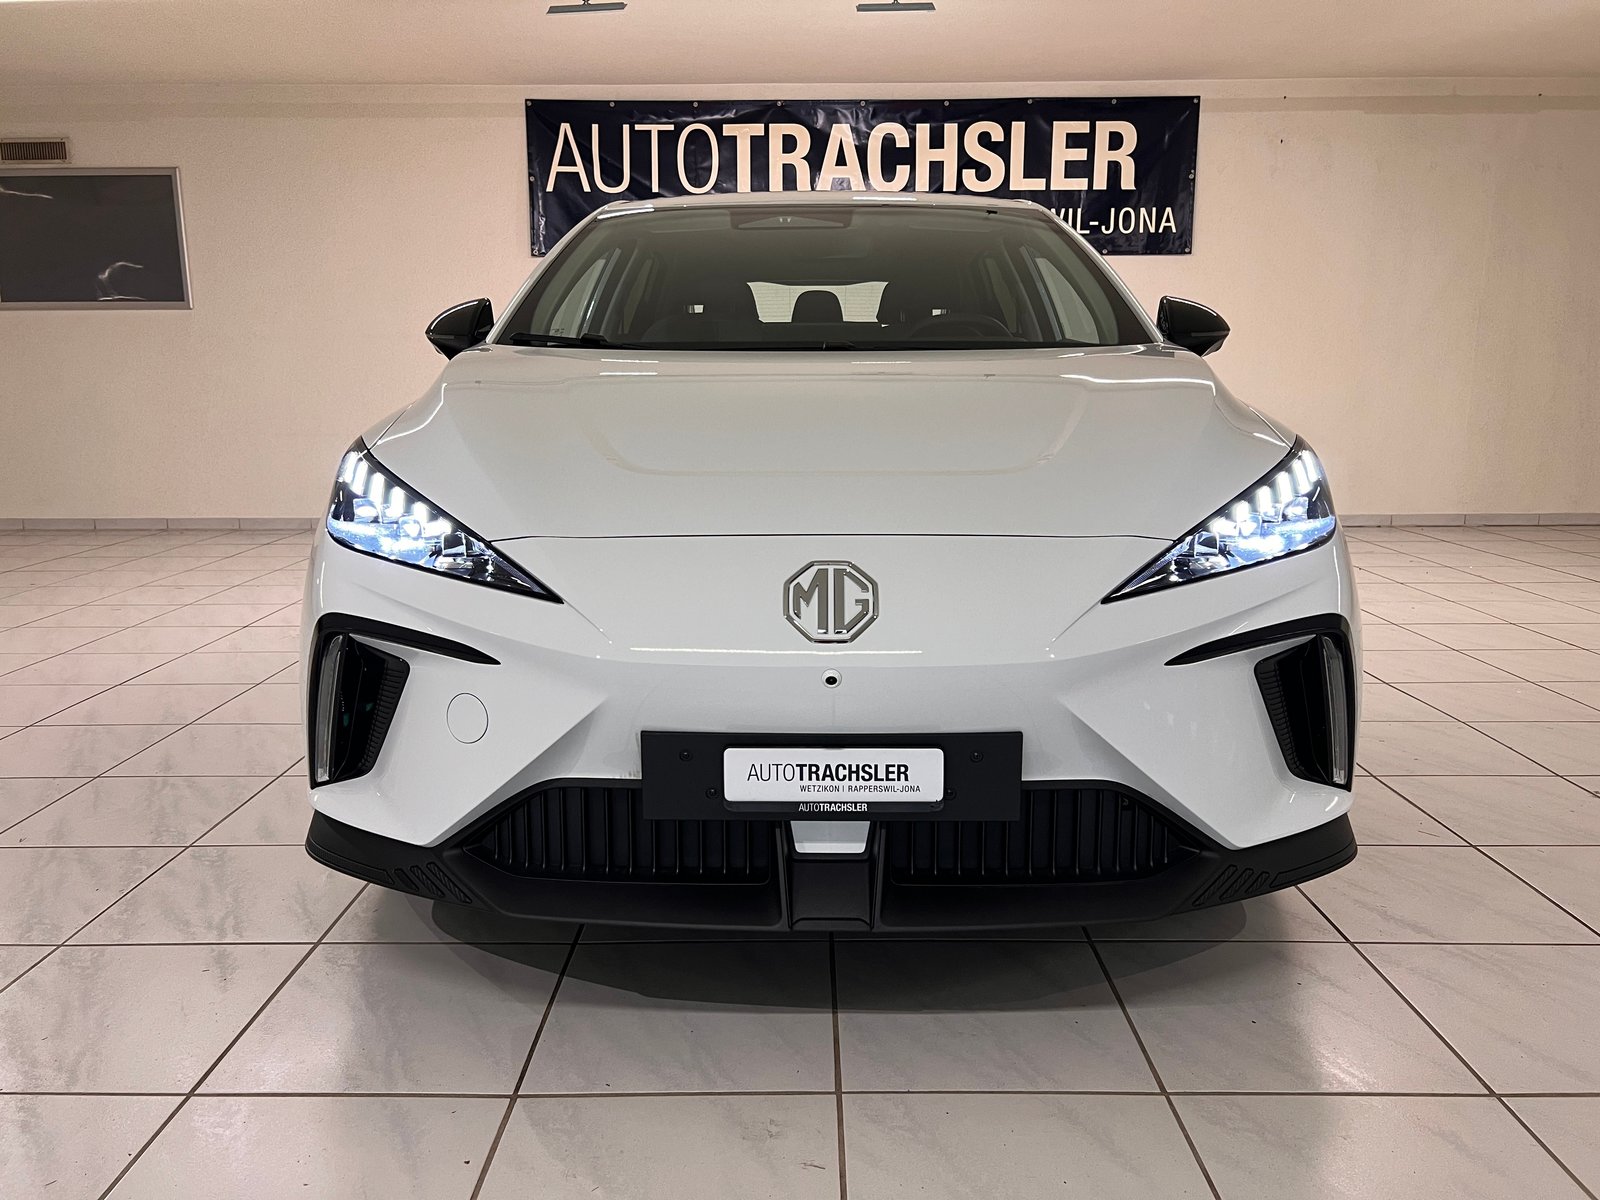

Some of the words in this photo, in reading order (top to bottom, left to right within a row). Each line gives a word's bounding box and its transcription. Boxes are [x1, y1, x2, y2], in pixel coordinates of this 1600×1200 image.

[546, 120, 1138, 194] AUTOTRACHSLER
[793, 567, 870, 635] MG
[747, 763, 909, 782] AUTOTRACHSLER
[800, 784, 840, 793] WETZIKON
[848, 784, 921, 793] RAPPERSWIL-JONA
[798, 803, 868, 812] AUTOTRACHSLER
